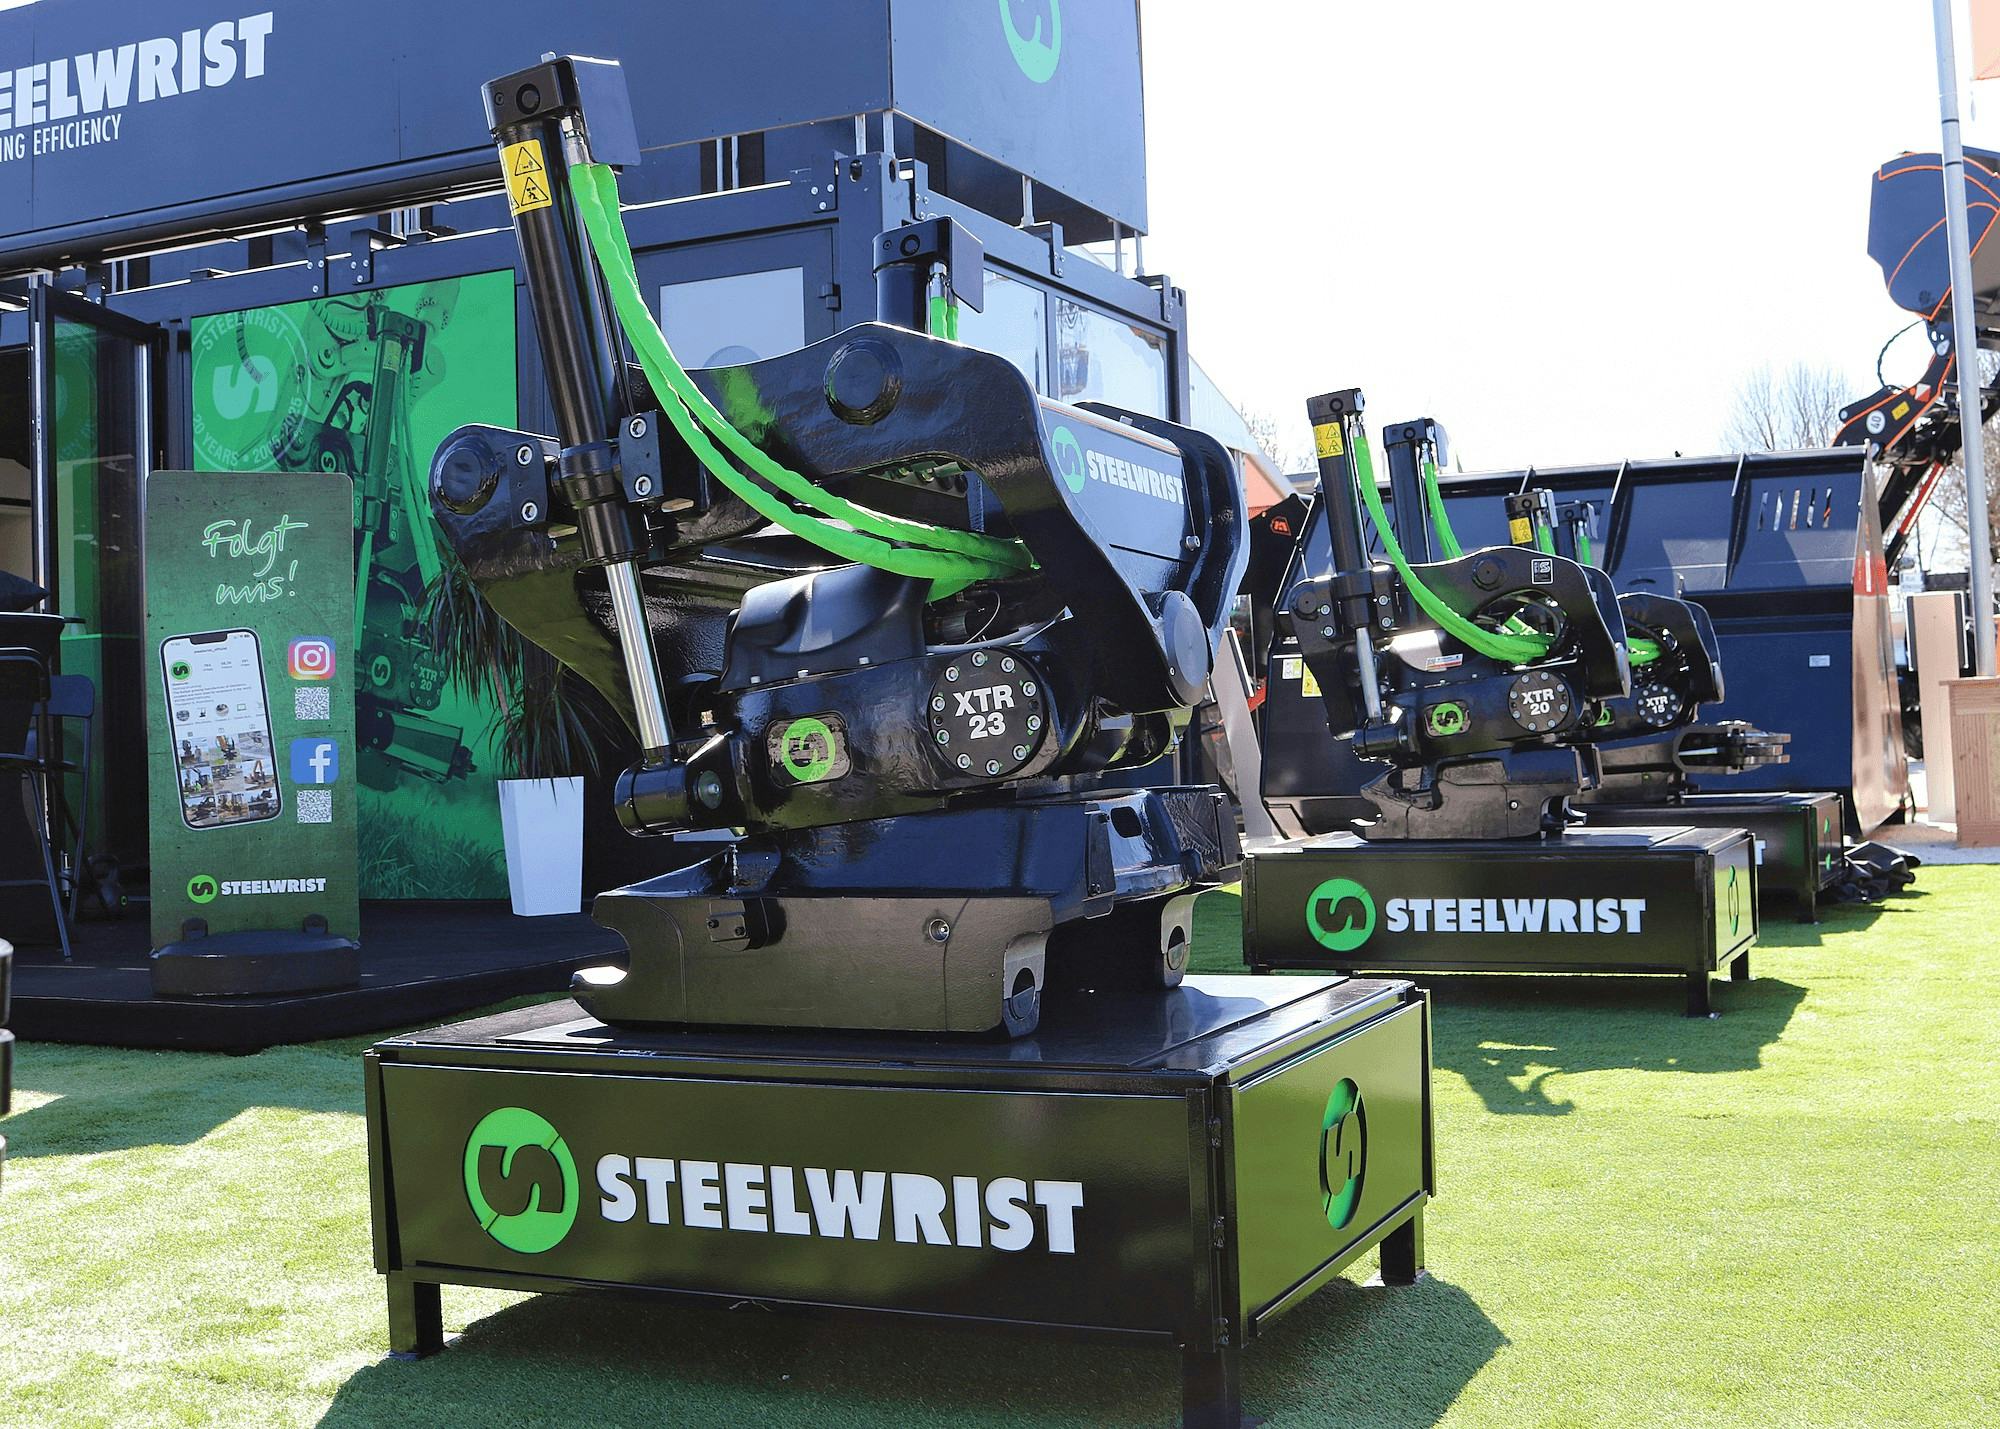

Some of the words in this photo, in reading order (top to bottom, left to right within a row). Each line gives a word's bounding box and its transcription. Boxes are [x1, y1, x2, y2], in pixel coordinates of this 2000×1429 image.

[33, 113, 122, 156] EFFICIENCY
[201, 310, 289, 351] STEELWRIST
[202, 431, 239, 466] YEARS
[1086, 449, 1185, 505] STEELWRIST
[202, 514, 309, 578] Folgt
[418, 666, 438, 682] XTR
[420, 680, 433, 692] 20
[952, 684, 1016, 717] XTR
[1521, 688, 1555, 705] XTR
[1530, 702, 1550, 716] 20
[1646, 695, 1669, 708] XTR
[1651, 704, 1666, 714] 15
[968, 711, 1007, 740] 23
[220, 877, 327, 896] STEELWRIST
[1385, 898, 1646, 935] STEELWRIST
[594, 1153, 1085, 1254] STEELWRIST
